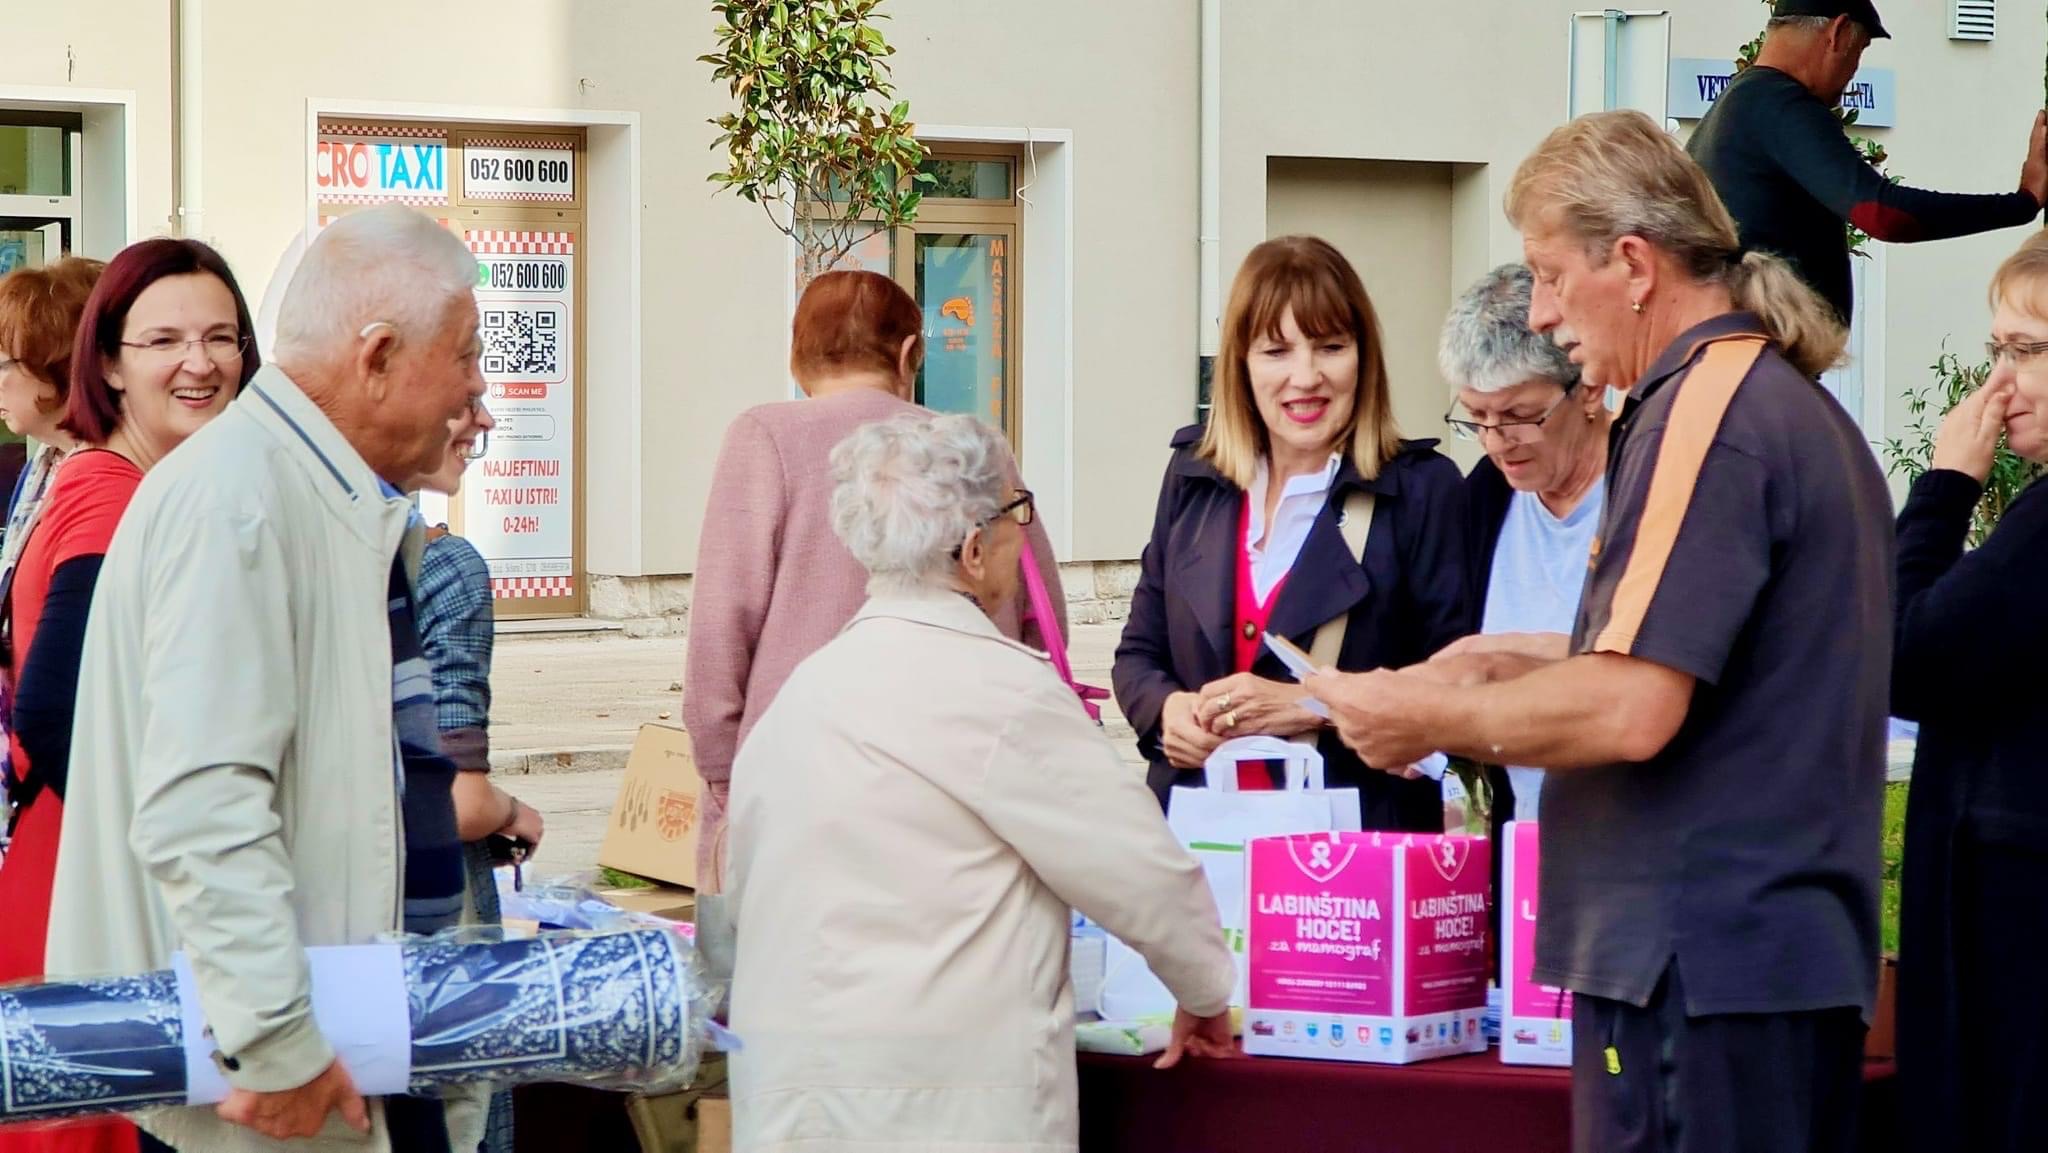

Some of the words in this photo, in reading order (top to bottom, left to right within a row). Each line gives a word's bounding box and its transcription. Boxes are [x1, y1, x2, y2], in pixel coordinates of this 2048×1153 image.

[1843, 82, 1875, 109] LANTA
[317, 141, 370, 187] CRO
[376, 143, 443, 190] TAXI
[470, 158, 500, 181] 052
[504, 159, 534, 182] 600
[538, 160, 568, 183] 600
[491, 262, 514, 288] 052
[517, 263, 539, 288] 600
[542, 263, 565, 289] 600
[483, 460, 559, 477] NAJJEFTINIJI
[484, 488, 512, 504] TAXI
[515, 488, 523, 504] U
[526, 487, 558, 505] ISTRI!
[504, 516, 539, 533] 0-24h!
[1258, 891, 1381, 920] LABINŠTINA
[1412, 890, 1485, 919] LABINŠTINA
